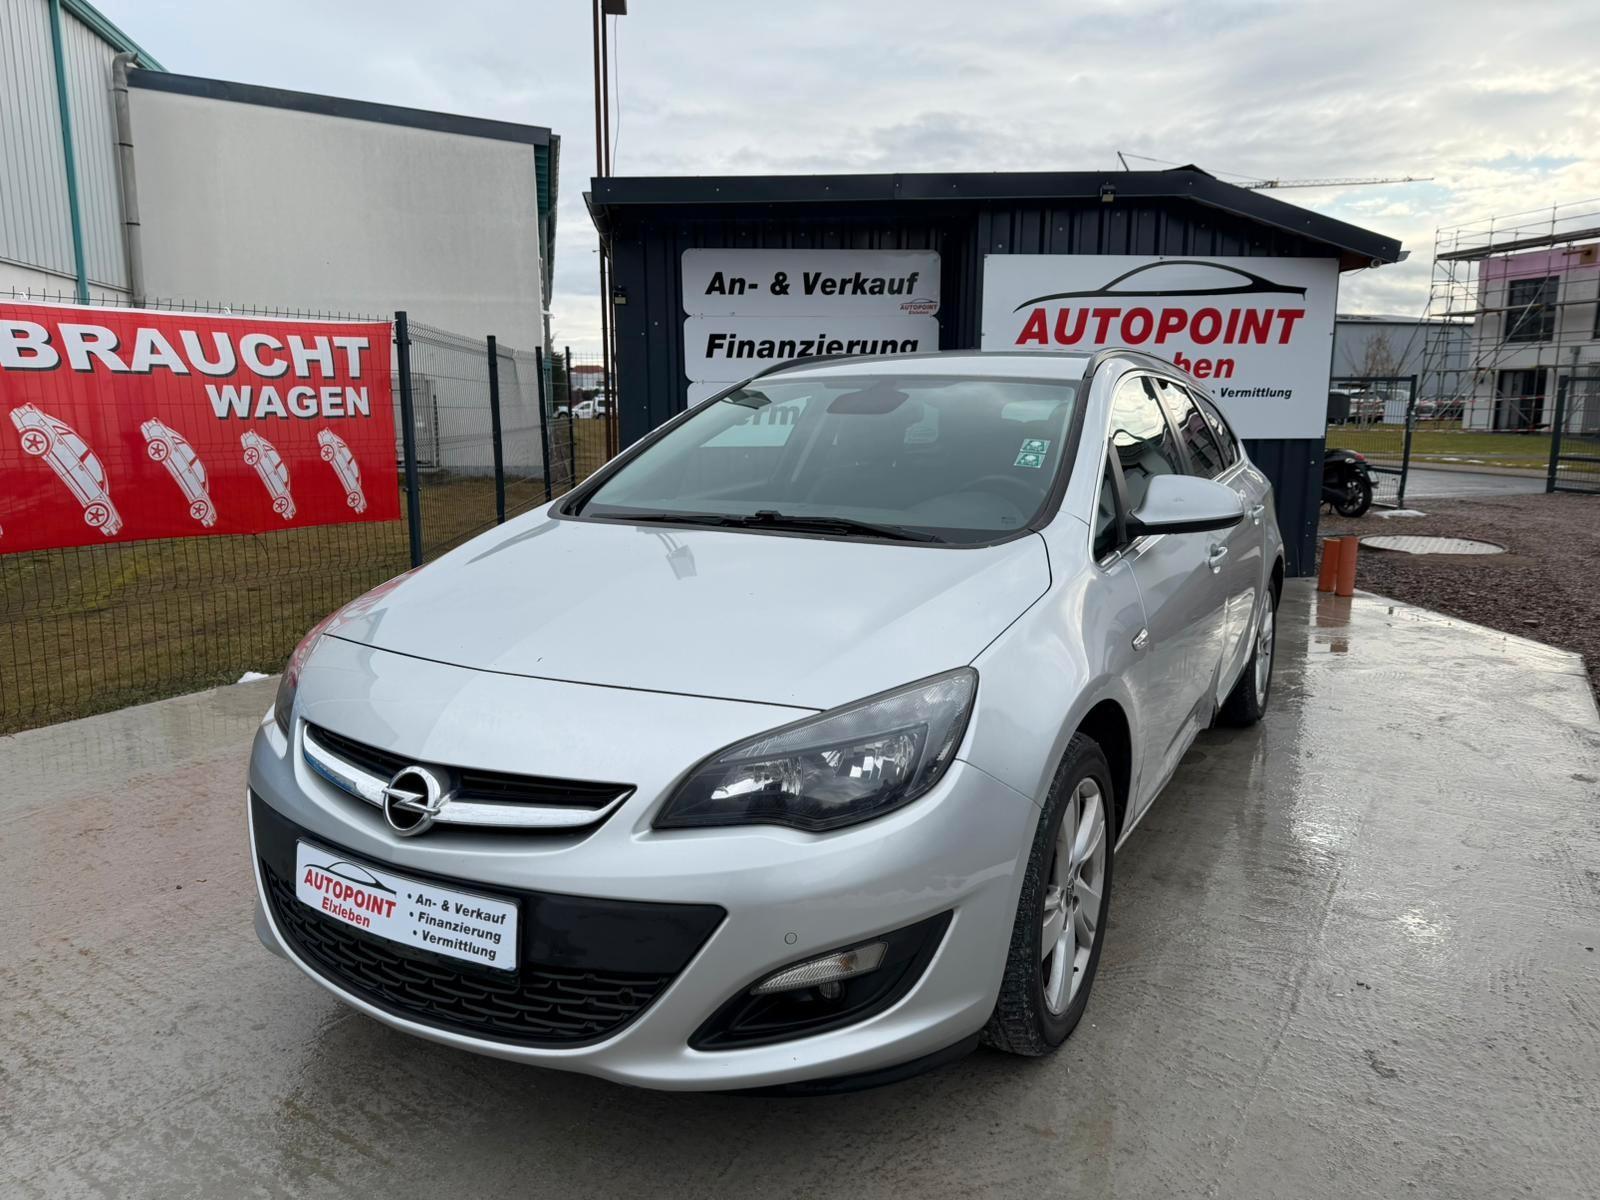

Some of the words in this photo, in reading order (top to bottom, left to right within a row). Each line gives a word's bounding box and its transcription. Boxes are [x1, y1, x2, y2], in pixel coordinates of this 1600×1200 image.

[705, 272, 758, 296] An-
[770, 272, 790, 296] &
[802, 272, 919, 296] Verkauf
[1015, 307, 1305, 345] AUTOPOINT
[0, 318, 370, 379] BRAUCHT
[705, 333, 919, 359] Finanzierung
[204, 384, 370, 418] WAGEN
[1220, 387, 1293, 400] Vermittlung
[303, 868, 397, 919] AUTOPOINT
[415, 893, 437, 908] An-
[441, 899, 450, 911] &
[454, 902, 507, 925] Verkauf
[321, 896, 371, 928] Elxleben
[418, 911, 502, 944] Finanzierung
[421, 929, 497, 961] Vermittlung
